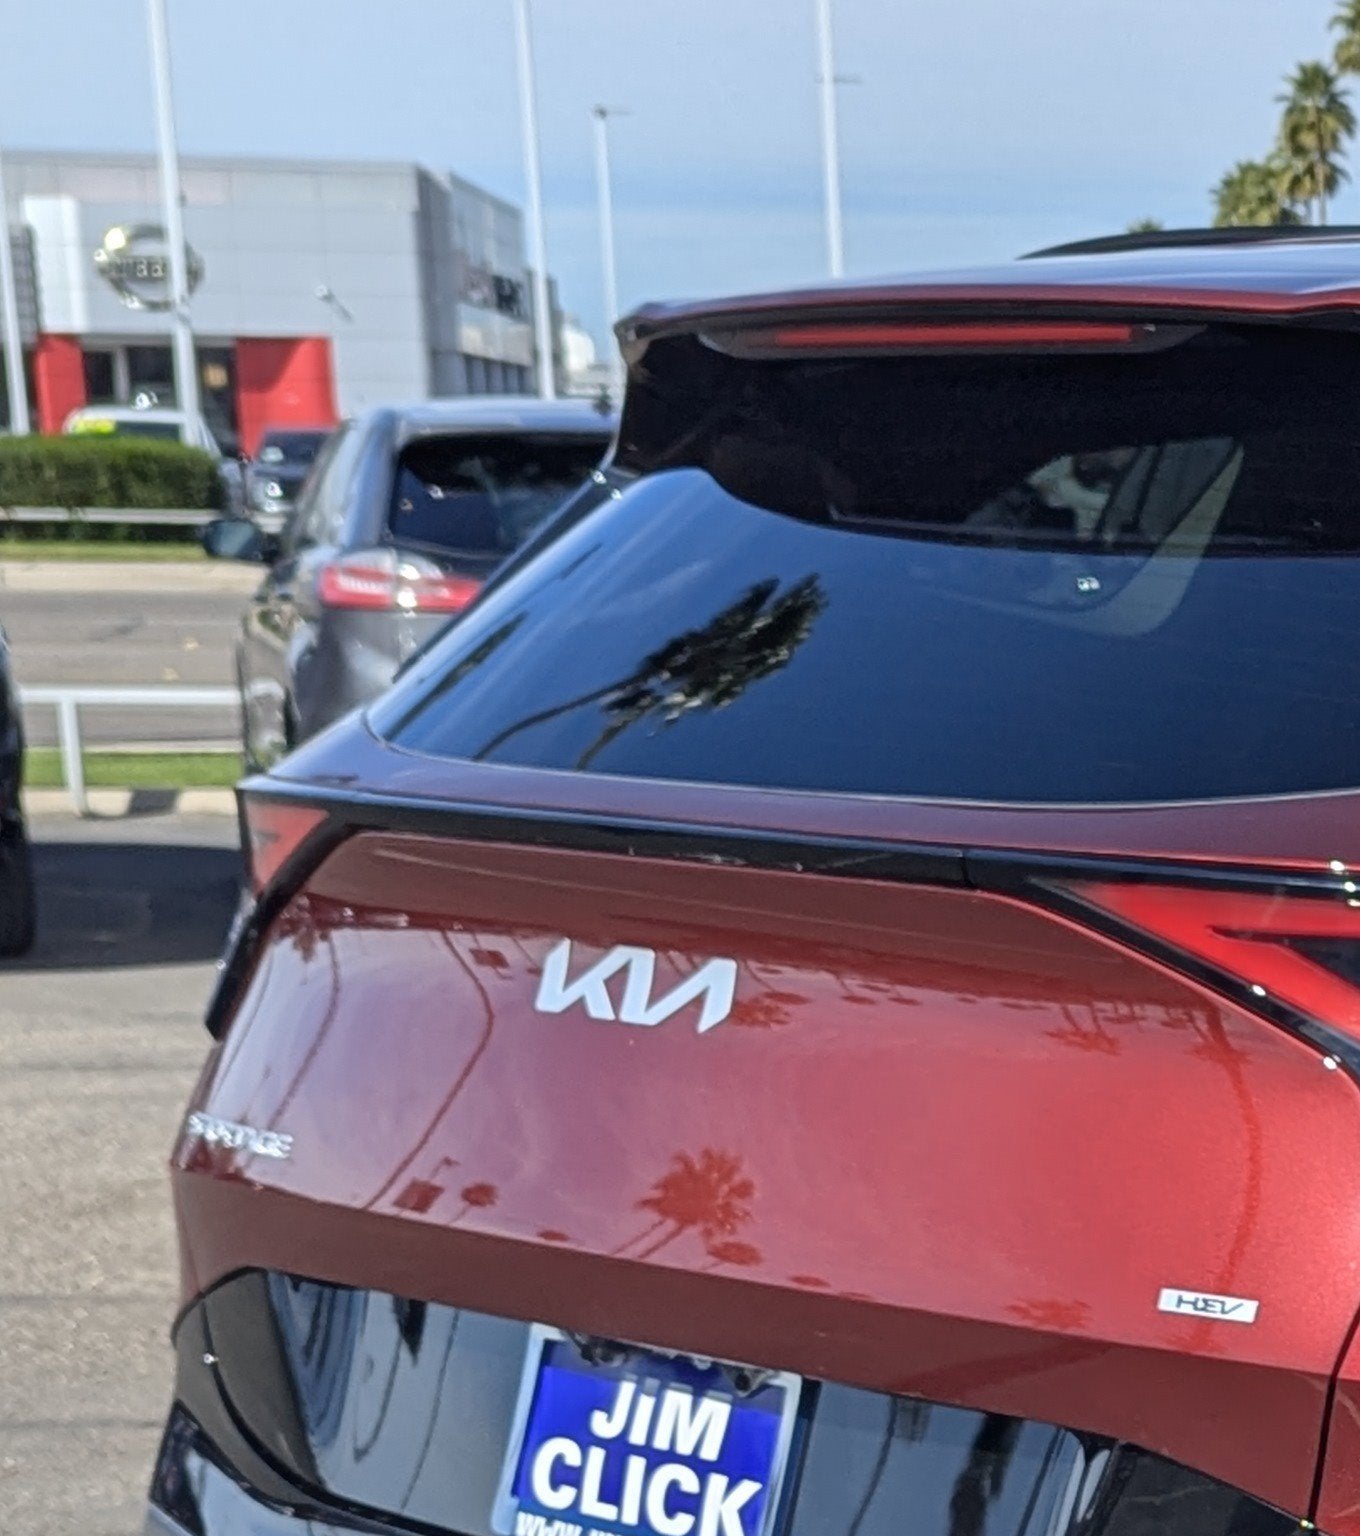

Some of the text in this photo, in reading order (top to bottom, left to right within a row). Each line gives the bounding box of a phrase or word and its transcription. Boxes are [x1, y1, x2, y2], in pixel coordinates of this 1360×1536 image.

[535, 936, 738, 1034] KIA
[1176, 1294, 1245, 1315] HEV
[589, 1372, 733, 1463] JIM
